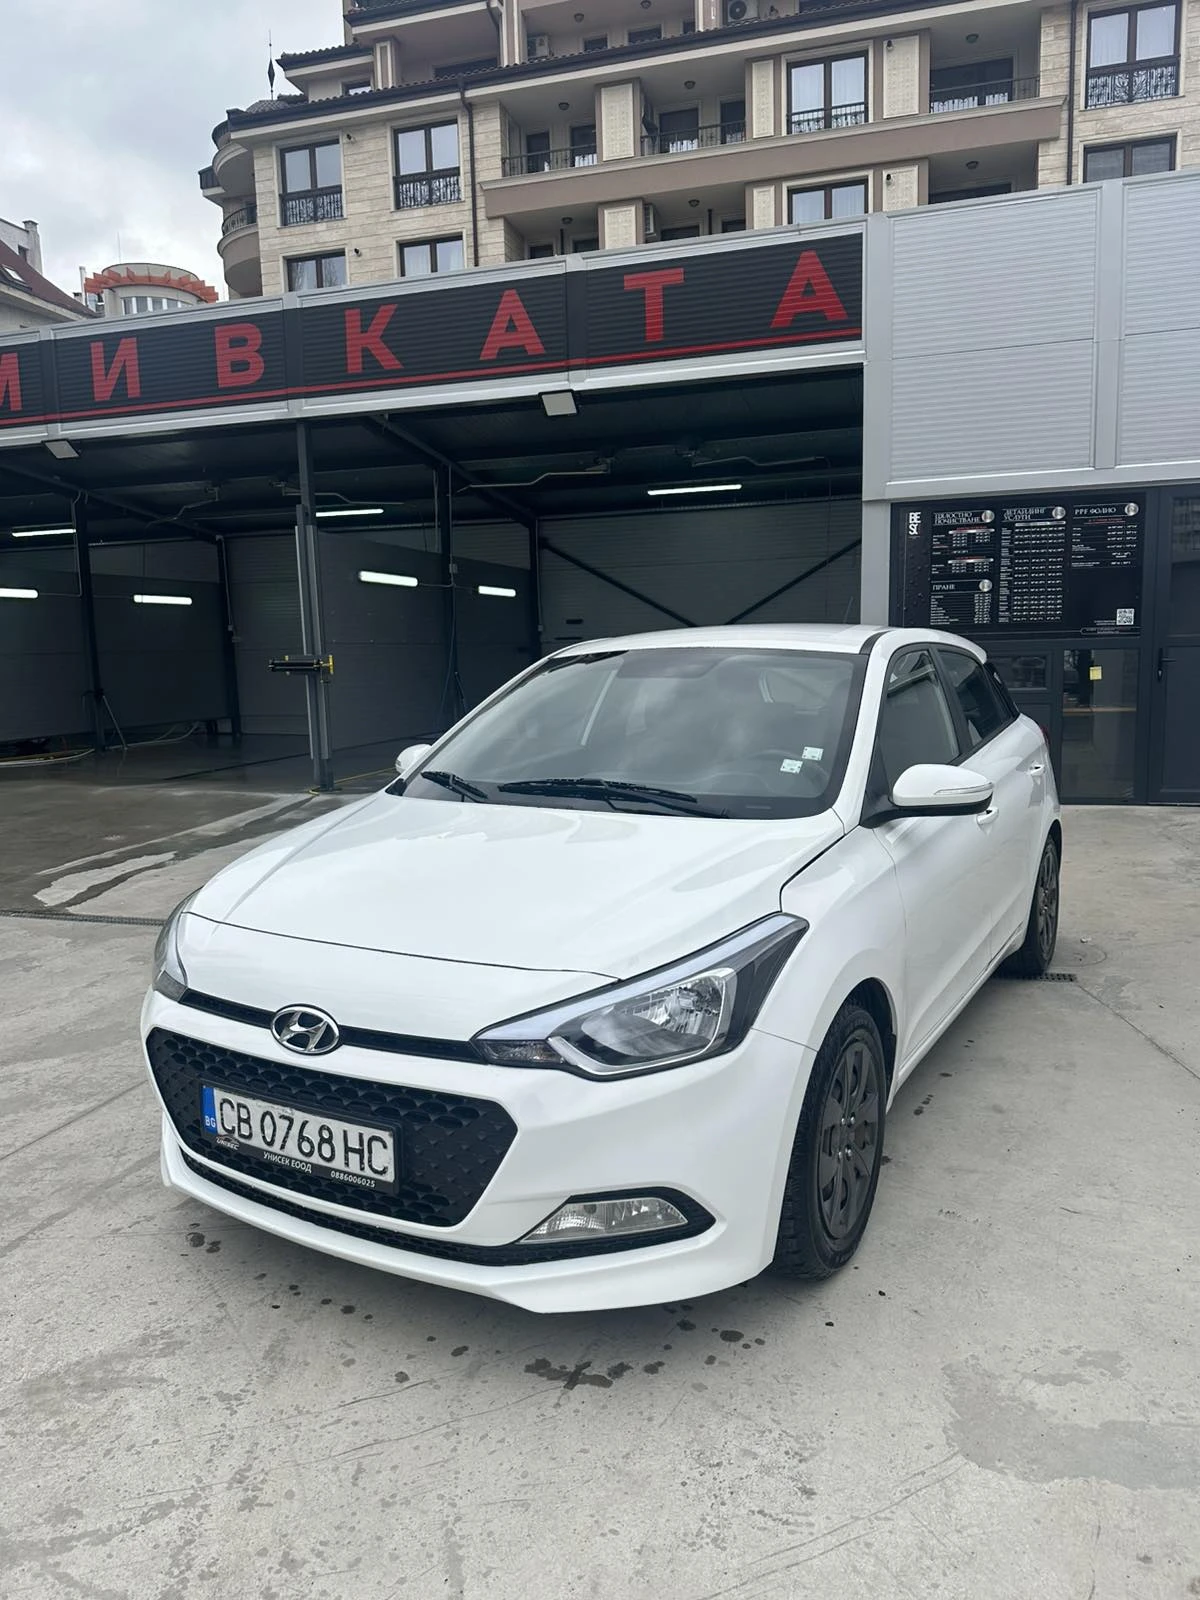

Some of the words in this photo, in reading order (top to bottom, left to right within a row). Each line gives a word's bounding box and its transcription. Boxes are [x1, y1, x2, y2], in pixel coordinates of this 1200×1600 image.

[933, 583, 956, 591] ПРАНЕ
[205, 1116, 217, 1128] BG
[219, 1098, 253, 1140] CB
[260, 1110, 336, 1163] 0768
[343, 1129, 388, 1175] HC
[263, 1151, 291, 1167] УНИСЕК
[291, 1160, 312, 1174] ЕООД
[331, 1170, 376, 1188] 0886006025
